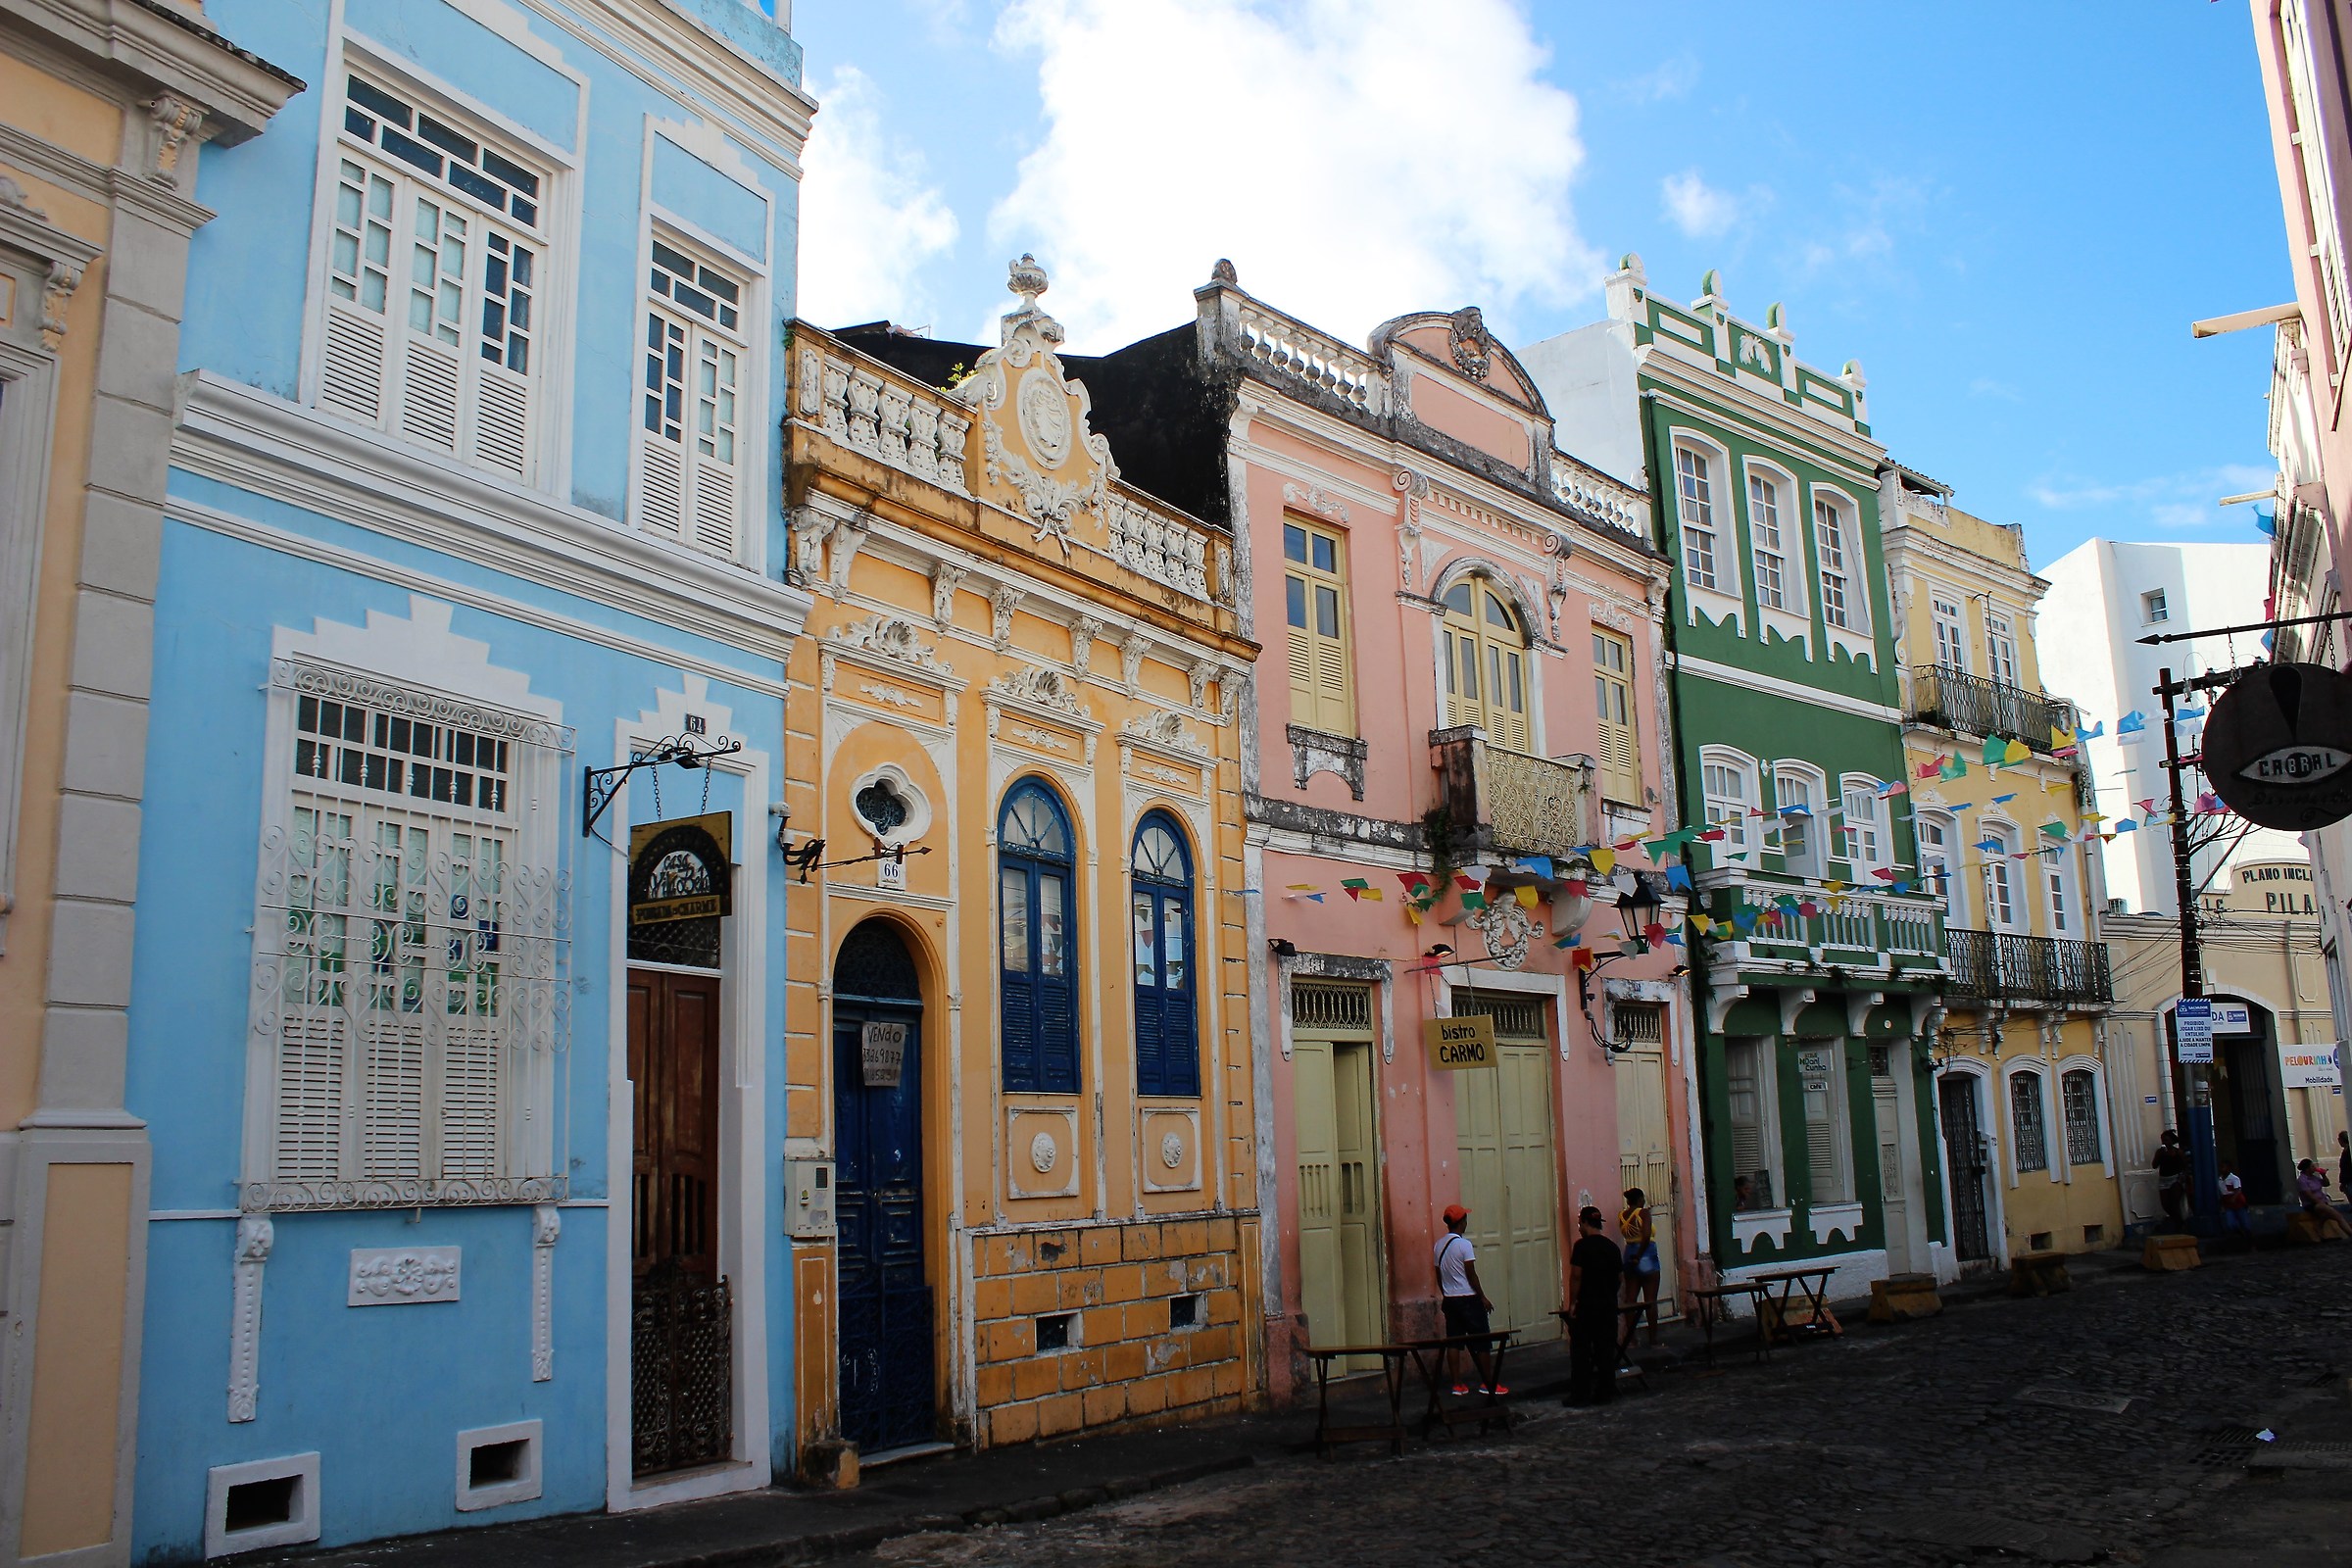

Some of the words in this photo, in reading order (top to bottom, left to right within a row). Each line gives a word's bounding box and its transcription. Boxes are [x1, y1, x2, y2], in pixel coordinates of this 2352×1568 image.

[690, 716, 703, 733] 64
[2258, 753, 2336, 777] CABRAL
[884, 863, 899, 877] 66
[2242, 867, 2280, 883] PLANO
[2266, 892, 2314, 915] PILA
[1441, 1024, 1476, 1040] bistro
[1440, 1043, 1485, 1063] CARMO
[2284, 1054, 2332, 1066] PELOURINHO
